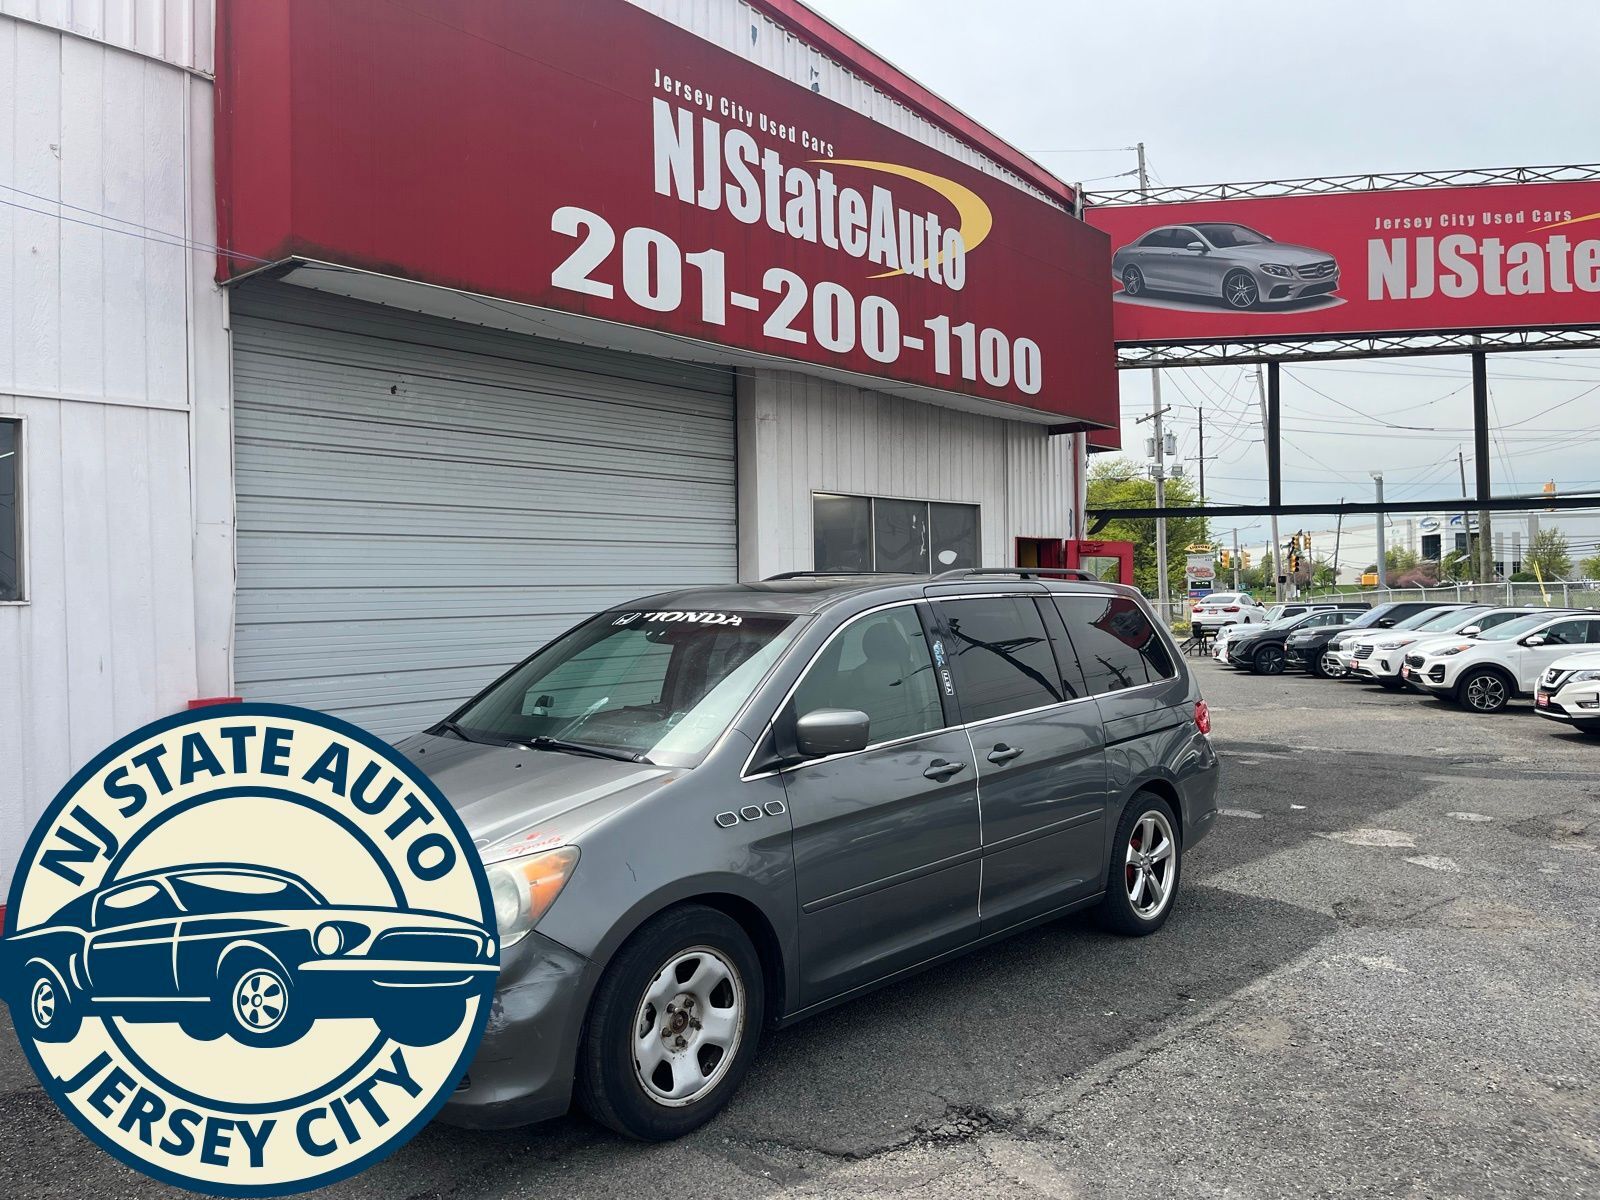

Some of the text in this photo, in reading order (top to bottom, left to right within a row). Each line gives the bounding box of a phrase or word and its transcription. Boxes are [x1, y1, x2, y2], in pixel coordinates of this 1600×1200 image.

[654, 68, 834, 157] Jersey City Used Cars
[653, 96, 966, 291] NJStateAuto
[1375, 209, 1572, 230] Jersey City Used Cars
[550, 206, 1042, 395] 201-200-1100
